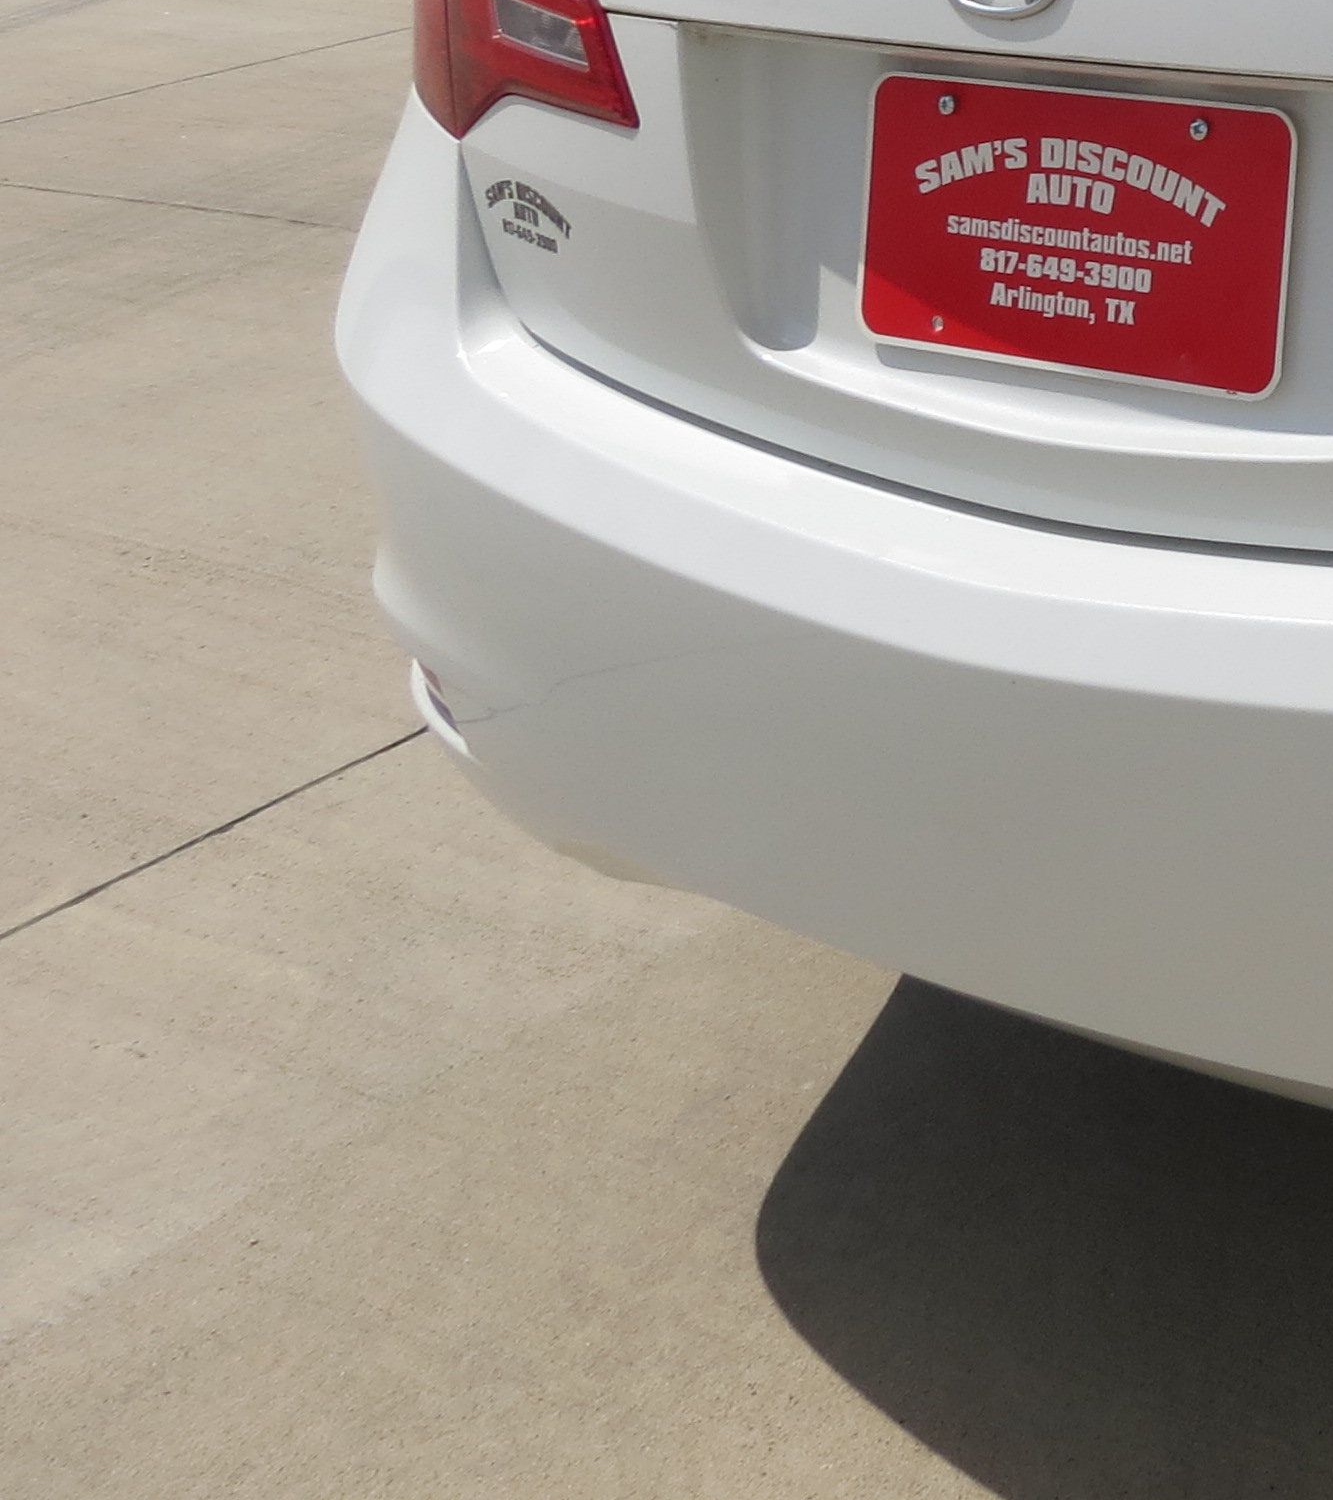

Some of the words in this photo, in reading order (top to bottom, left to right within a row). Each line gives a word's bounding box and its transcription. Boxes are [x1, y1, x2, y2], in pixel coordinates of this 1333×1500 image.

[915, 138, 1027, 193] SAM'S
[1041, 138, 1226, 227] DISCOUNT
[1027, 174, 1115, 214] AUTO
[947, 215, 1193, 264] samsdiscountautos.net
[980, 248, 1151, 293] 817-649-3900
[990, 282, 1095, 324] Arlington,
[1105, 298, 1135, 324] TX
